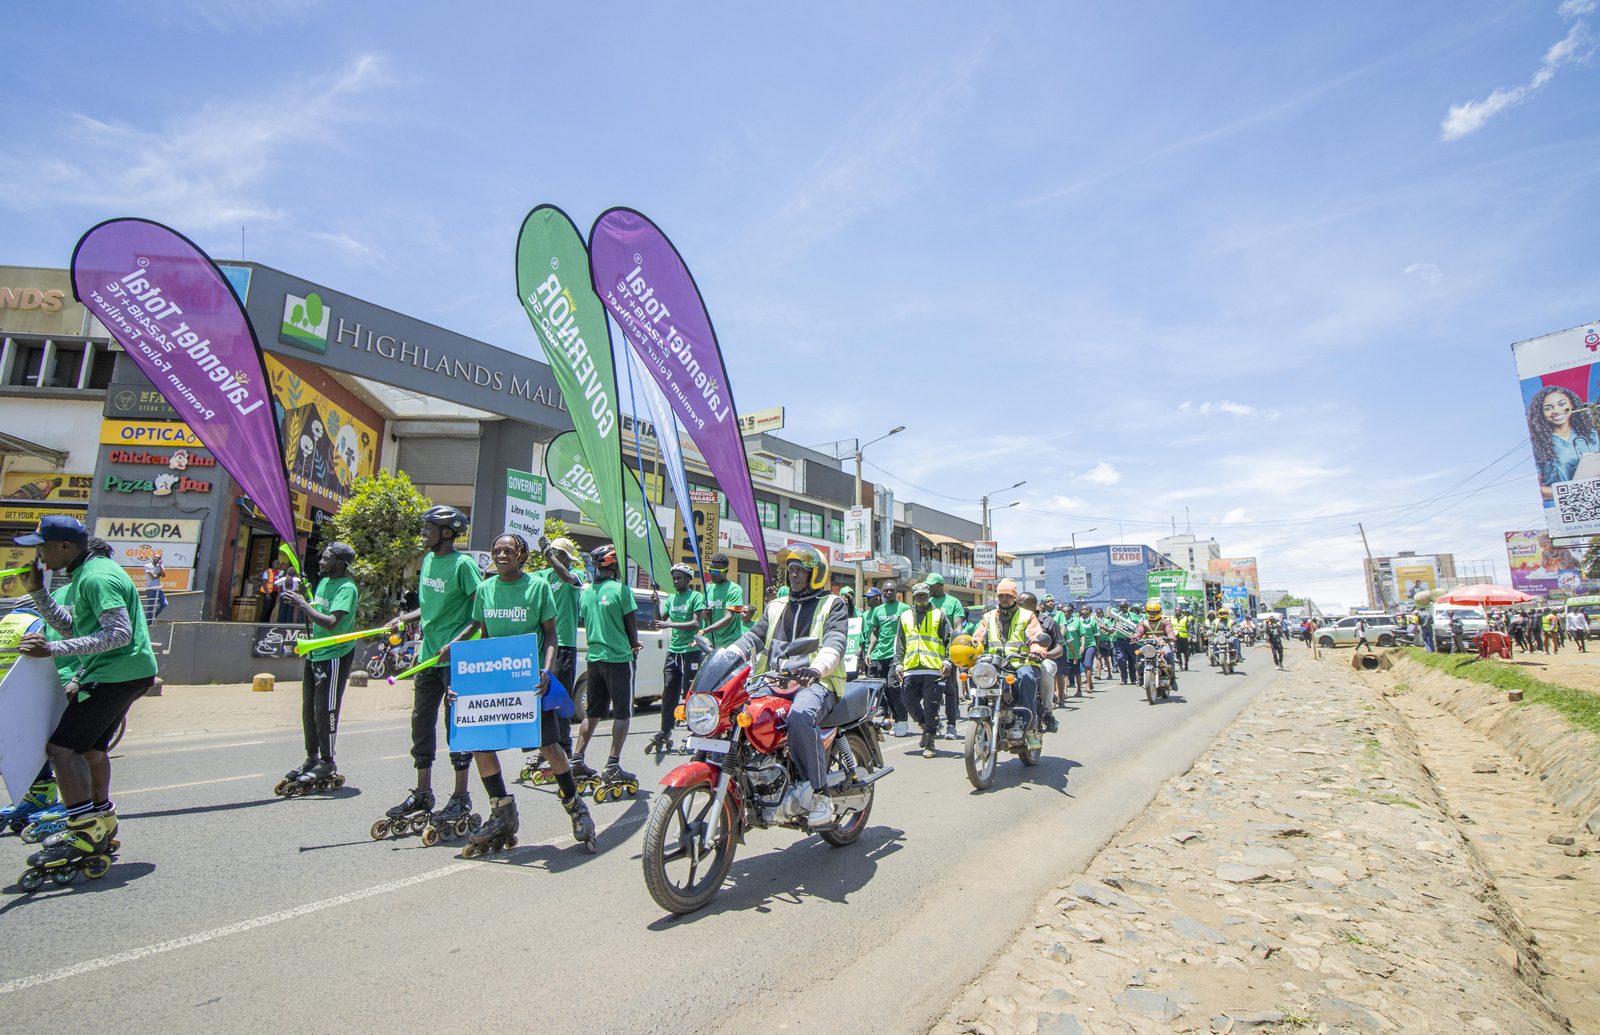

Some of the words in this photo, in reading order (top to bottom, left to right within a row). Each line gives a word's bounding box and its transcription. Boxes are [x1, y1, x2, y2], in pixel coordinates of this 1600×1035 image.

[335, 317, 503, 390] HIGHLANDS
[509, 374, 567, 411] MALL
[622, 415, 657, 438] ETIA
[739, 416, 755, 427] A'S
[121, 427, 185, 441] OPTICA
[109, 449, 169, 465] Chicken
[187, 453, 216, 467] Inn
[103, 474, 154, 493] Pizza
[177, 476, 210, 493] Inn
[508, 476, 543, 496] GOVERNOR
[4, 511, 16, 519] GET
[17, 511, 34, 520] YOUR
[511, 504, 525, 516] Litre
[524, 508, 540, 521] Moja
[108, 522, 182, 538] M-KOPA
[509, 520, 522, 531] Acre
[1112, 552, 1141, 561] EXIDE
[483, 608, 527, 619] GOVERNOR
[457, 657, 532, 675] BenzoRon
[468, 697, 522, 709] ANGAMIZA
[456, 715, 476, 724] FALL
[477, 711, 535, 723] ARMYWORMS
